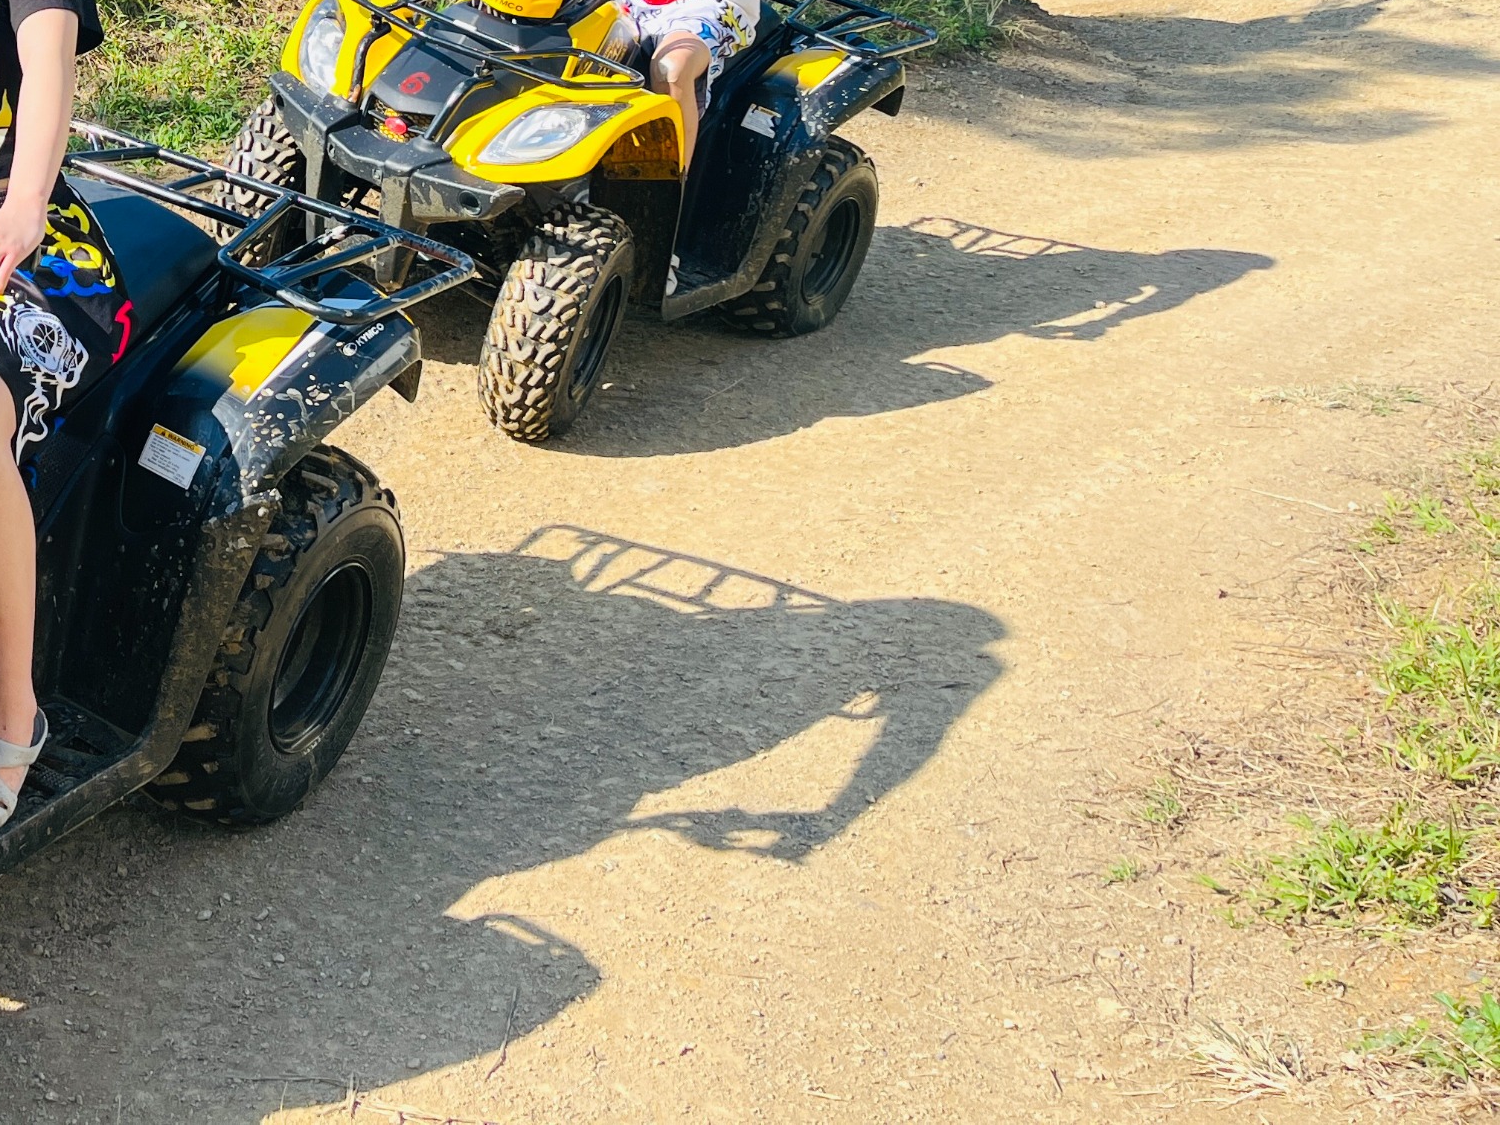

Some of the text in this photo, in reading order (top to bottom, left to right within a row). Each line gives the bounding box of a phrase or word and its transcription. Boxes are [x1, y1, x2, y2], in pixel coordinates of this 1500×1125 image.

[399, 71, 431, 95] 6
[355, 322, 385, 347] KYMCO
[167, 432, 195, 452] WARNING
